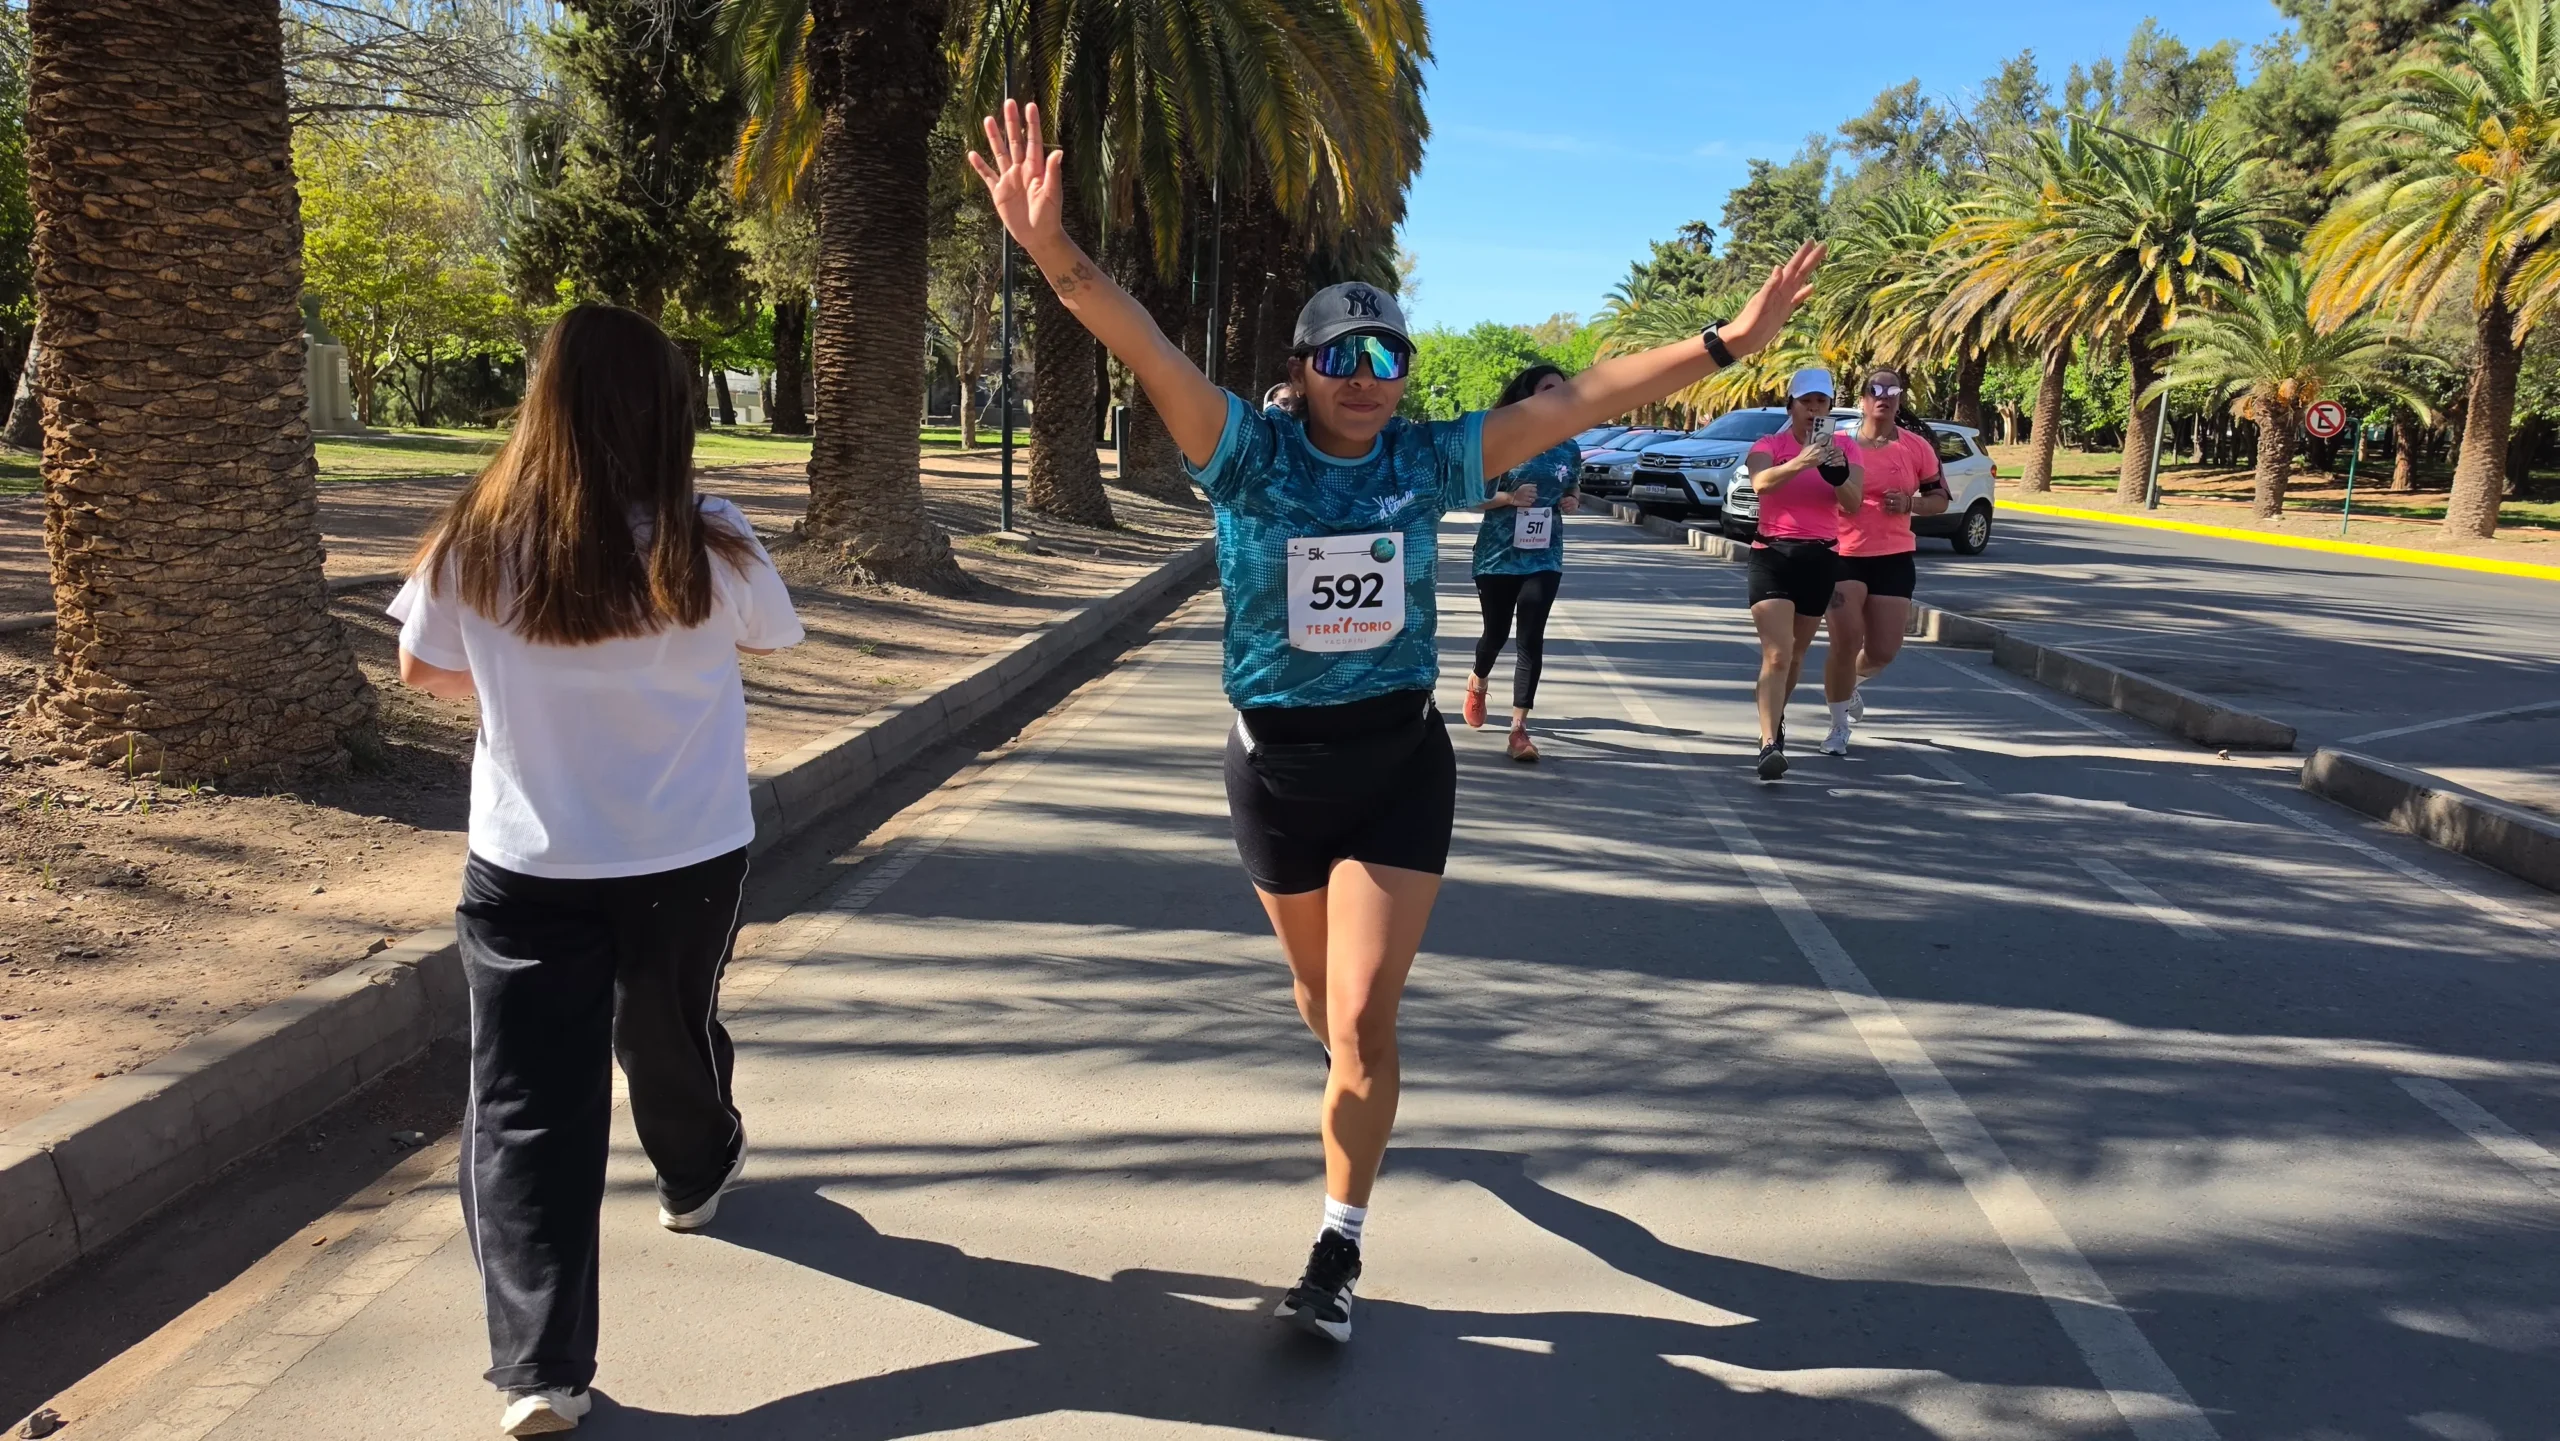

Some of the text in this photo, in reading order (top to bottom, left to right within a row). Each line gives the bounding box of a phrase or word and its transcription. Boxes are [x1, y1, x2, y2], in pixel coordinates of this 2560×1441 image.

[1343, 289, 1382, 318] NY
[1526, 521, 1544, 534] 511
[1308, 547, 1325, 560] 5k
[1309, 572, 1384, 610] 592
[1306, 616, 1392, 635] TERRITORIO
